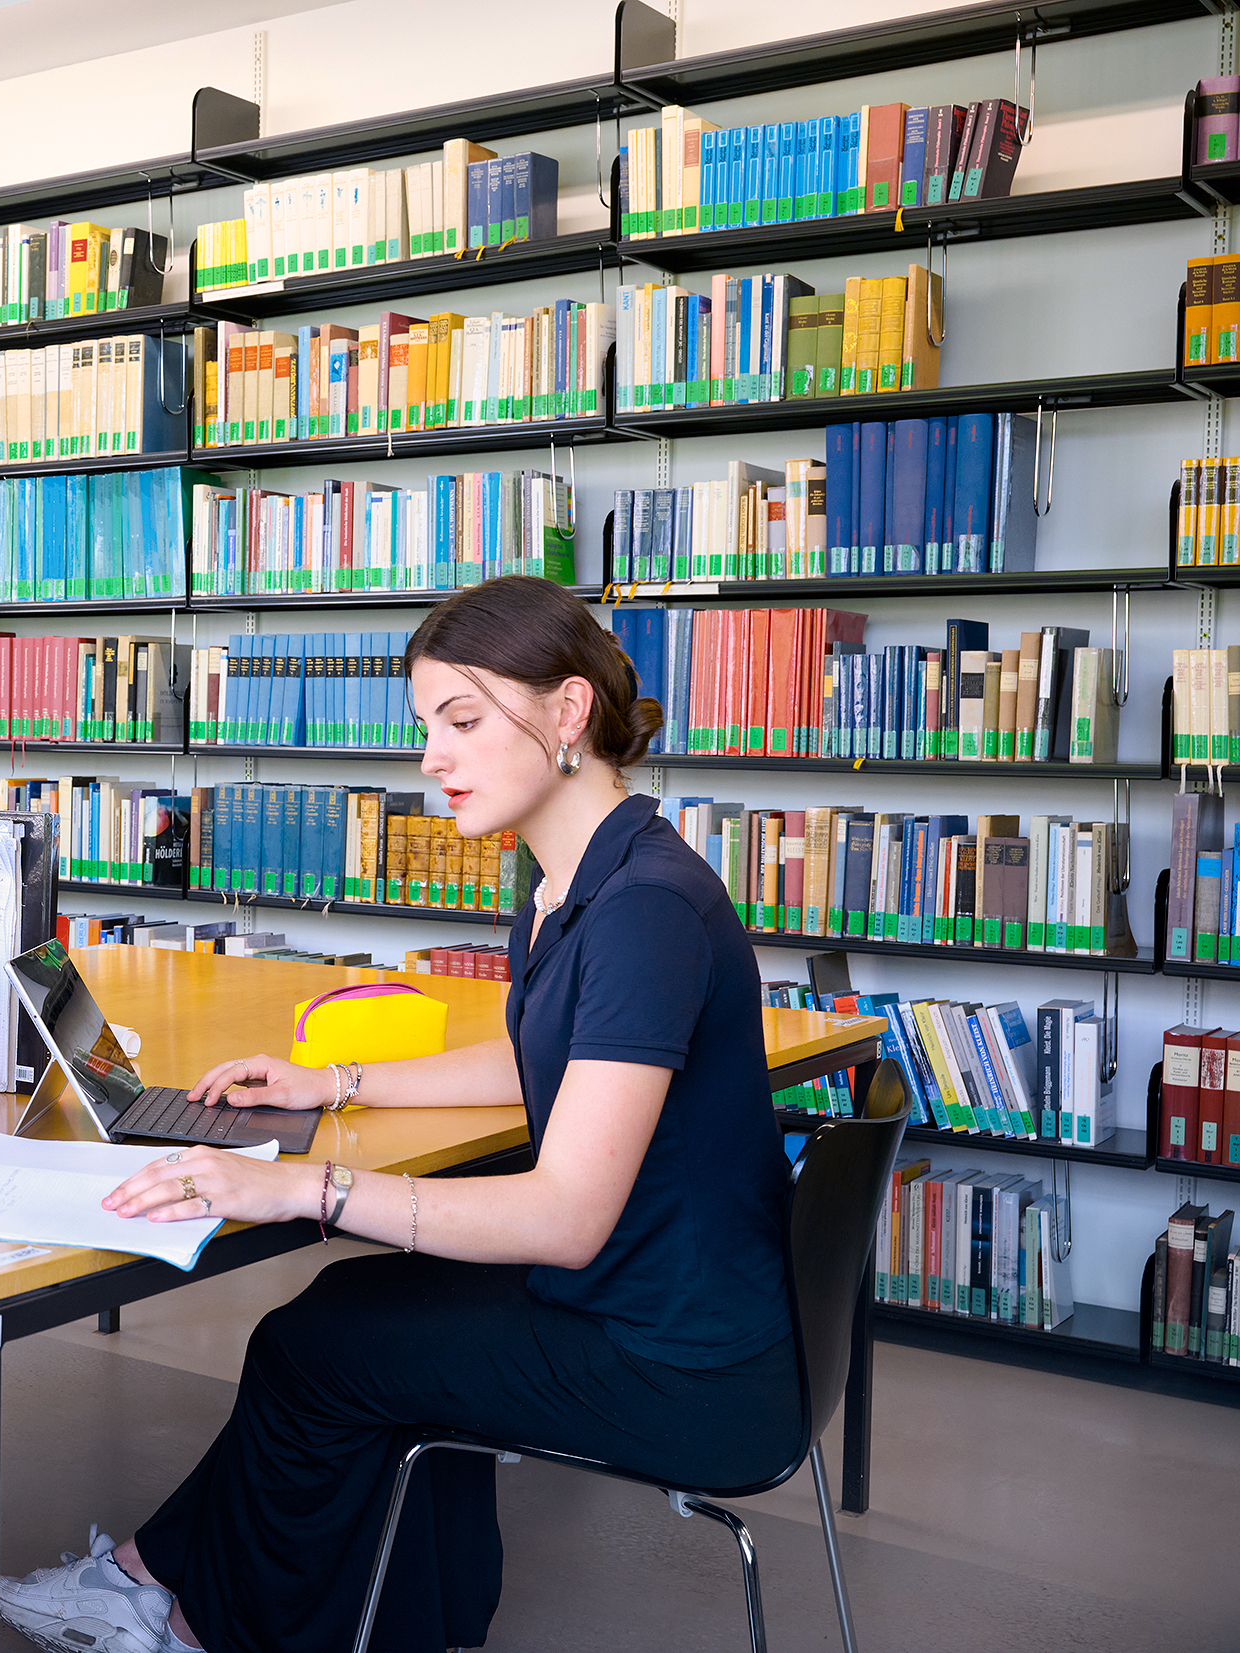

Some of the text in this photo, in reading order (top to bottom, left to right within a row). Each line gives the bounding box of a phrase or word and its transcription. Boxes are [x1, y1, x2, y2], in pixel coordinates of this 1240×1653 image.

[1044, 1016, 1052, 1030] Magie
[971, 1023, 998, 1093] HEINRICH VON KLEIST
[1044, 1066, 1052, 1094] Brüggemann
